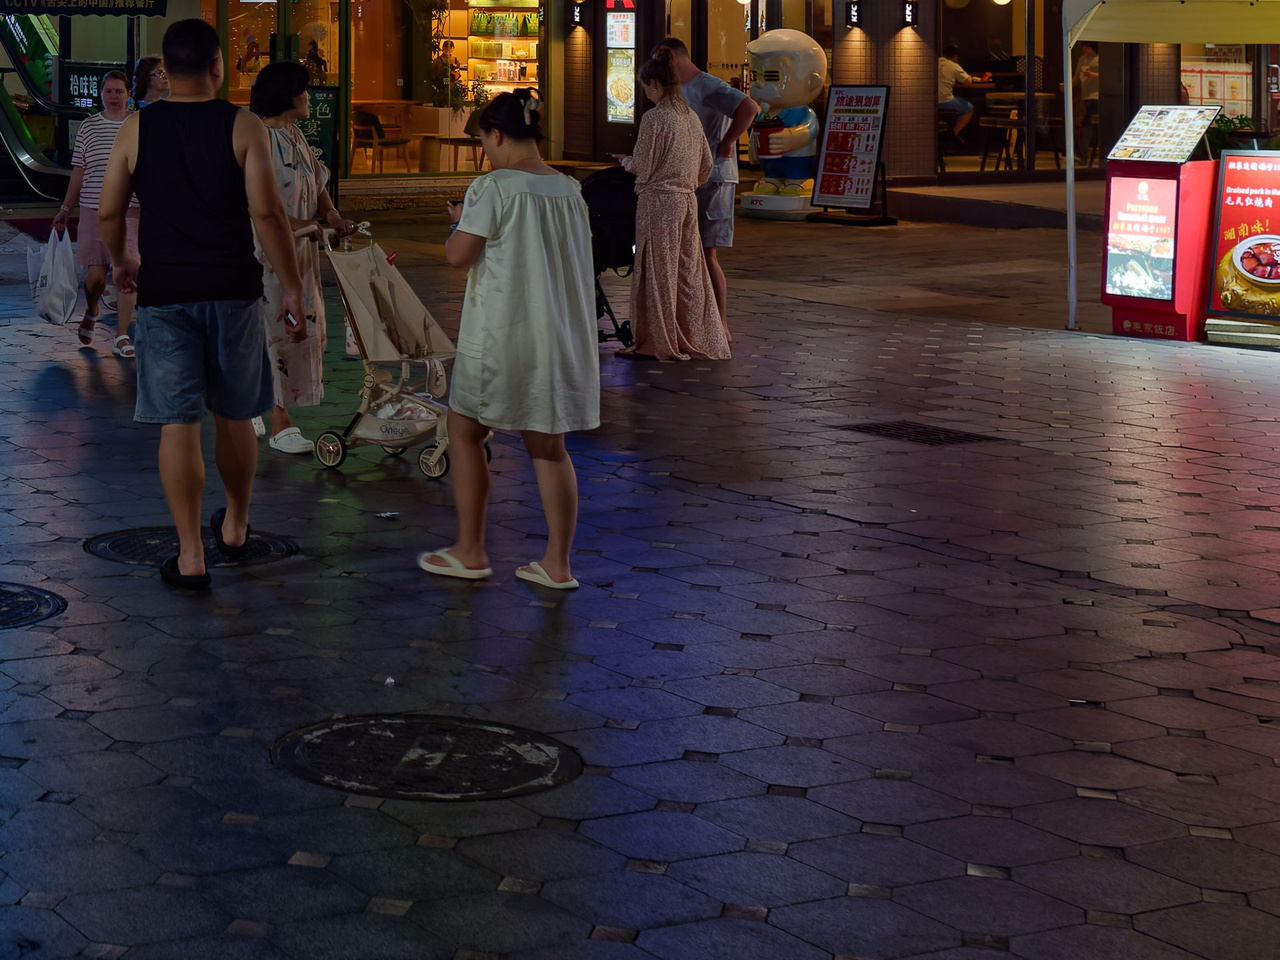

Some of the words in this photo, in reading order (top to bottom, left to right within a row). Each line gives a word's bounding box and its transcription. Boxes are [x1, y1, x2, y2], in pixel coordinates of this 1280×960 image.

[573, 5, 581, 22] KFC
[850, 3, 858, 23] KFC
[904, 3, 913, 22] KFC
[70, 74, 99, 98] 拾味馆
[1226, 186, 1250, 195] Braised
[1250, 188, 1265, 196] pork
